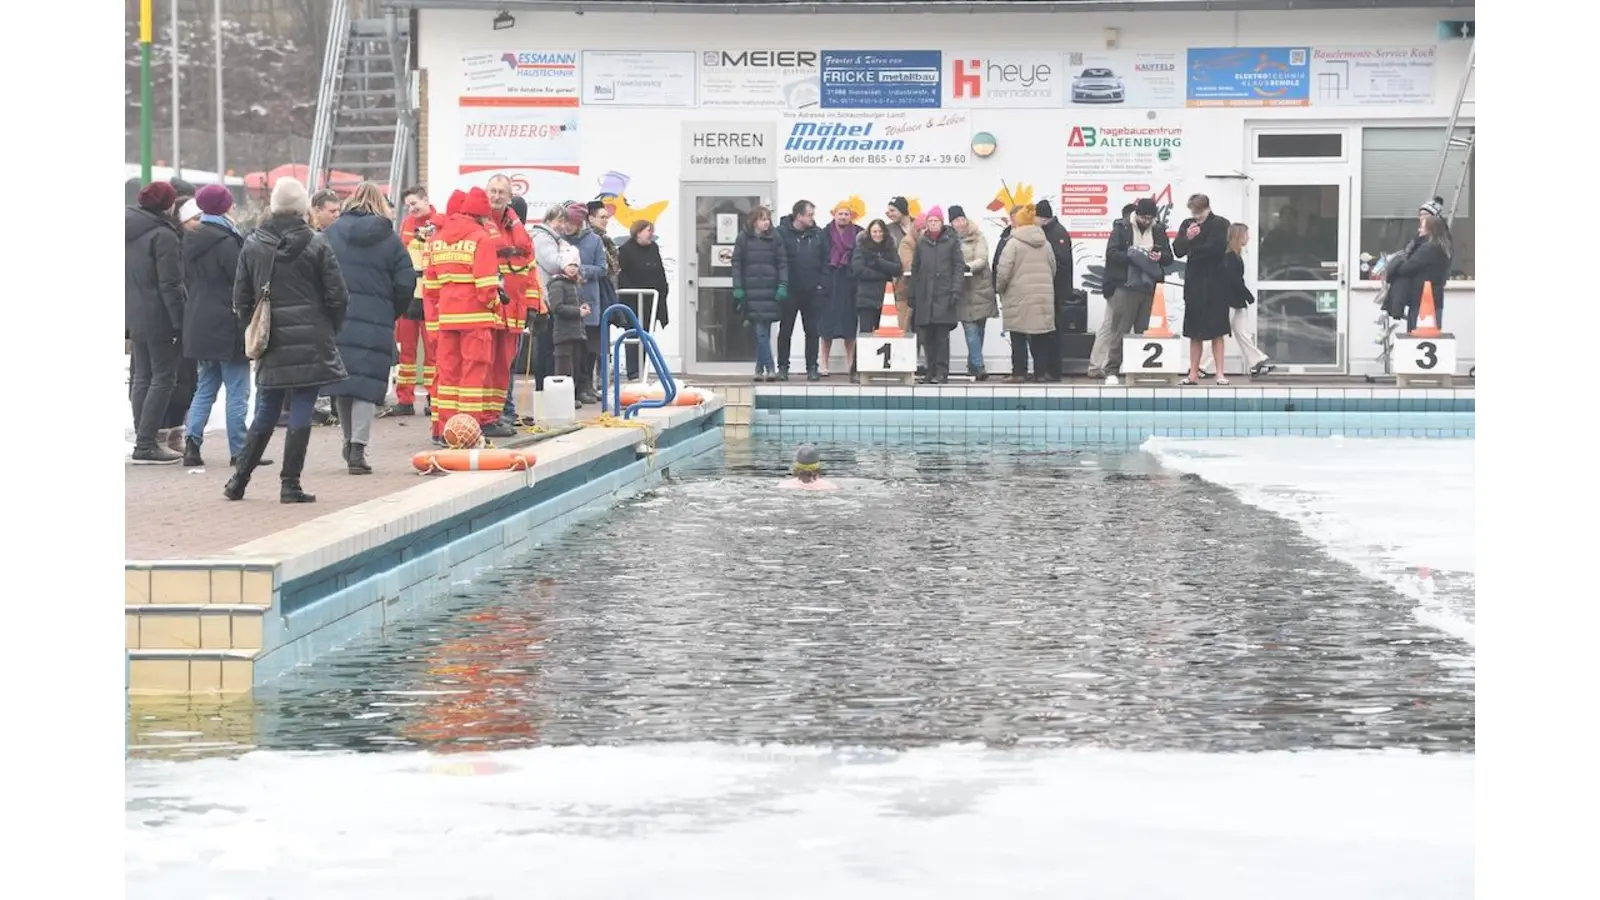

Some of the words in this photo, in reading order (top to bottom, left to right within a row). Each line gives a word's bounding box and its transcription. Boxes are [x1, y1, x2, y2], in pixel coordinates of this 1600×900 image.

[519, 53, 576, 64] ESSMANN
[722, 50, 817, 67] MEIER
[823, 71, 875, 83] FRICKE
[882, 72, 936, 81] metallbau
[987, 59, 1051, 87] heye
[987, 88, 1052, 98] international
[791, 122, 874, 136] Möbel
[1099, 126, 1182, 137] hagebaucentrum
[694, 133, 763, 147] HERREN
[784, 137, 905, 151] Hollmann
[1100, 138, 1181, 147] ALTENBURG
[690, 155, 730, 164] Garderobe
[734, 155, 767, 164] Toiletten
[833, 155, 846, 163] An
[849, 155, 864, 163] der
[868, 155, 887, 163] B65
[919, 155, 931, 163] 24
[876, 343, 891, 368] 1
[1142, 342, 1163, 368] 2
[1416, 341, 1437, 369] 3
